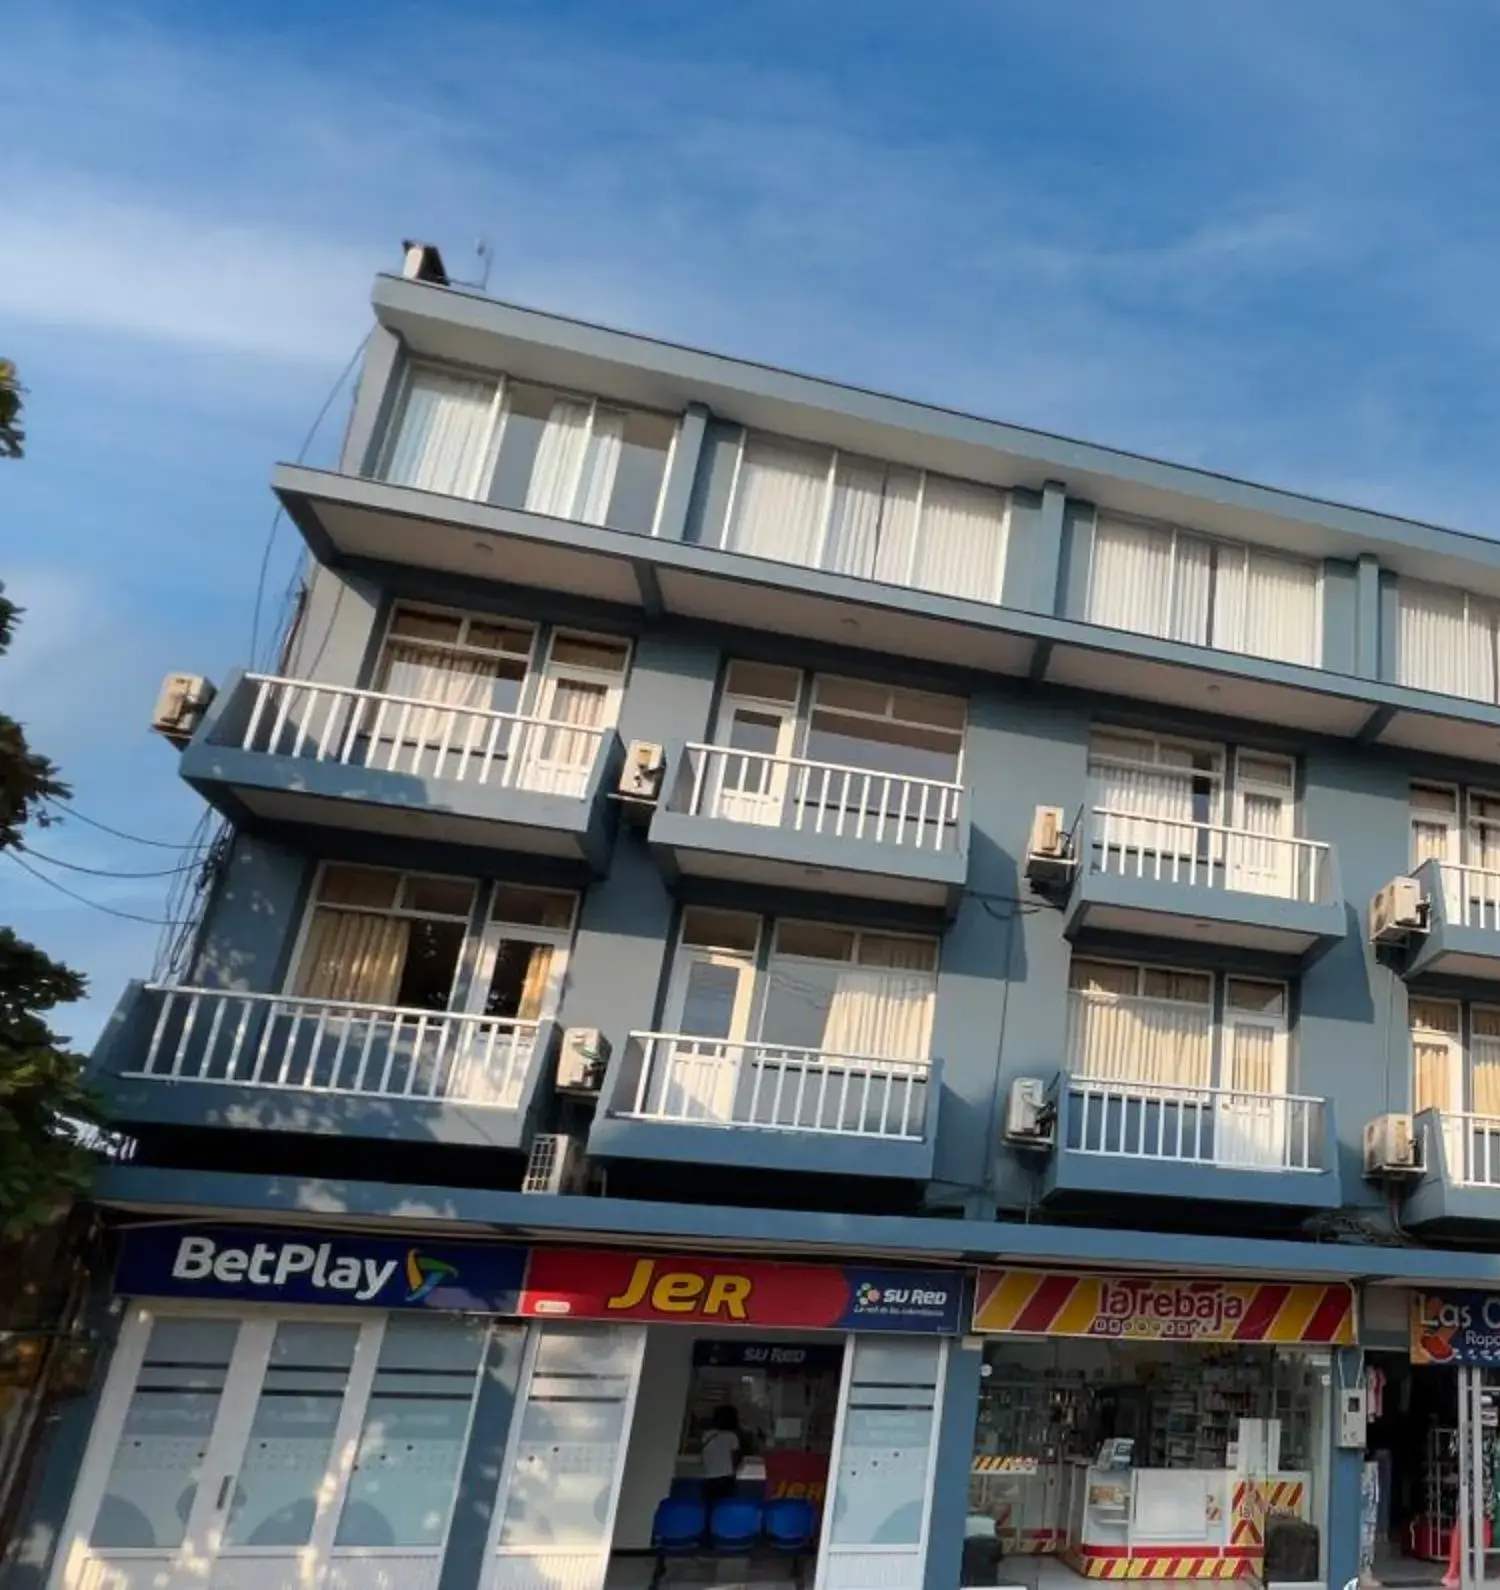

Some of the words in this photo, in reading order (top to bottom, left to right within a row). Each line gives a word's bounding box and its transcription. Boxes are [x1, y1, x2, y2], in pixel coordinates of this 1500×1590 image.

[172, 1236, 399, 1301] BetPlay
[883, 1288, 909, 1303] SU
[1138, 1288, 1242, 1331] rebaja
[1419, 1294, 1473, 1328] Las
